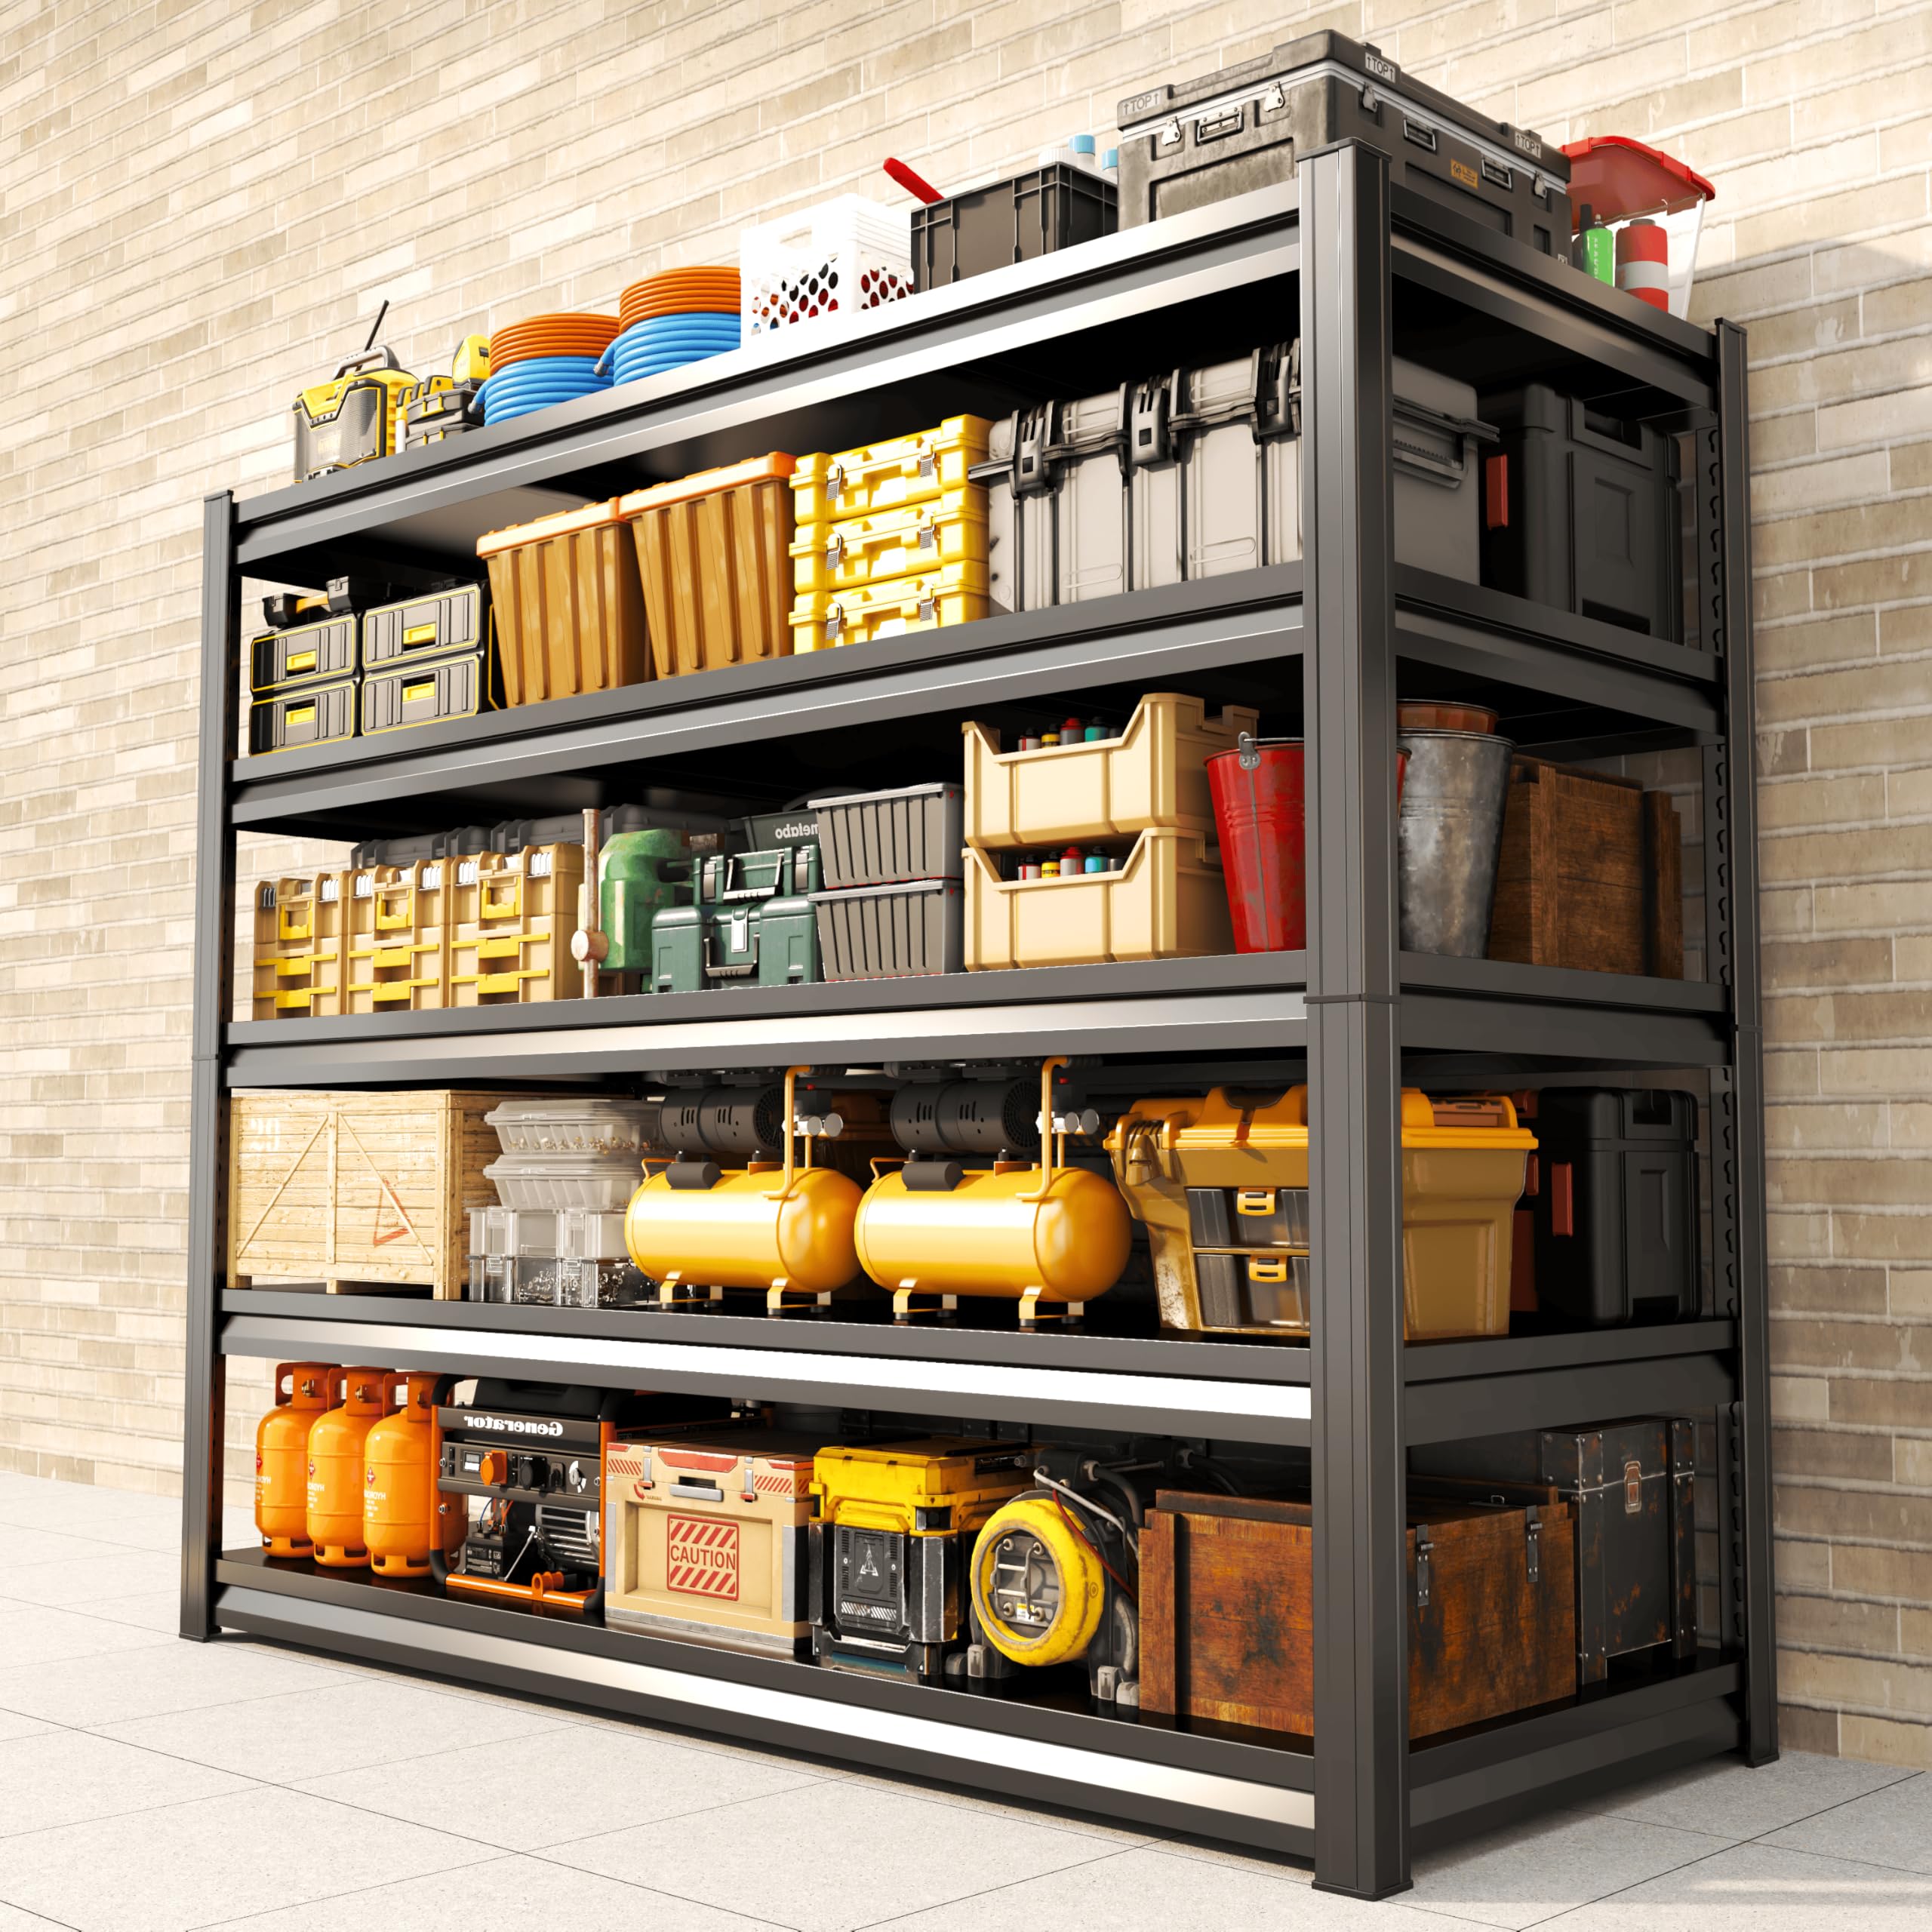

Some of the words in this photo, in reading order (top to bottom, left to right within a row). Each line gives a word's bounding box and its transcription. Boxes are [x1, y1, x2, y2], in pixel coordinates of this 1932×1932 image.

[1372, 57, 1389, 75] TOP
[1130, 94, 1152, 112] TOP
[1520, 135, 1535, 152] TOP
[670, 1544, 736, 1571] CAUTION
